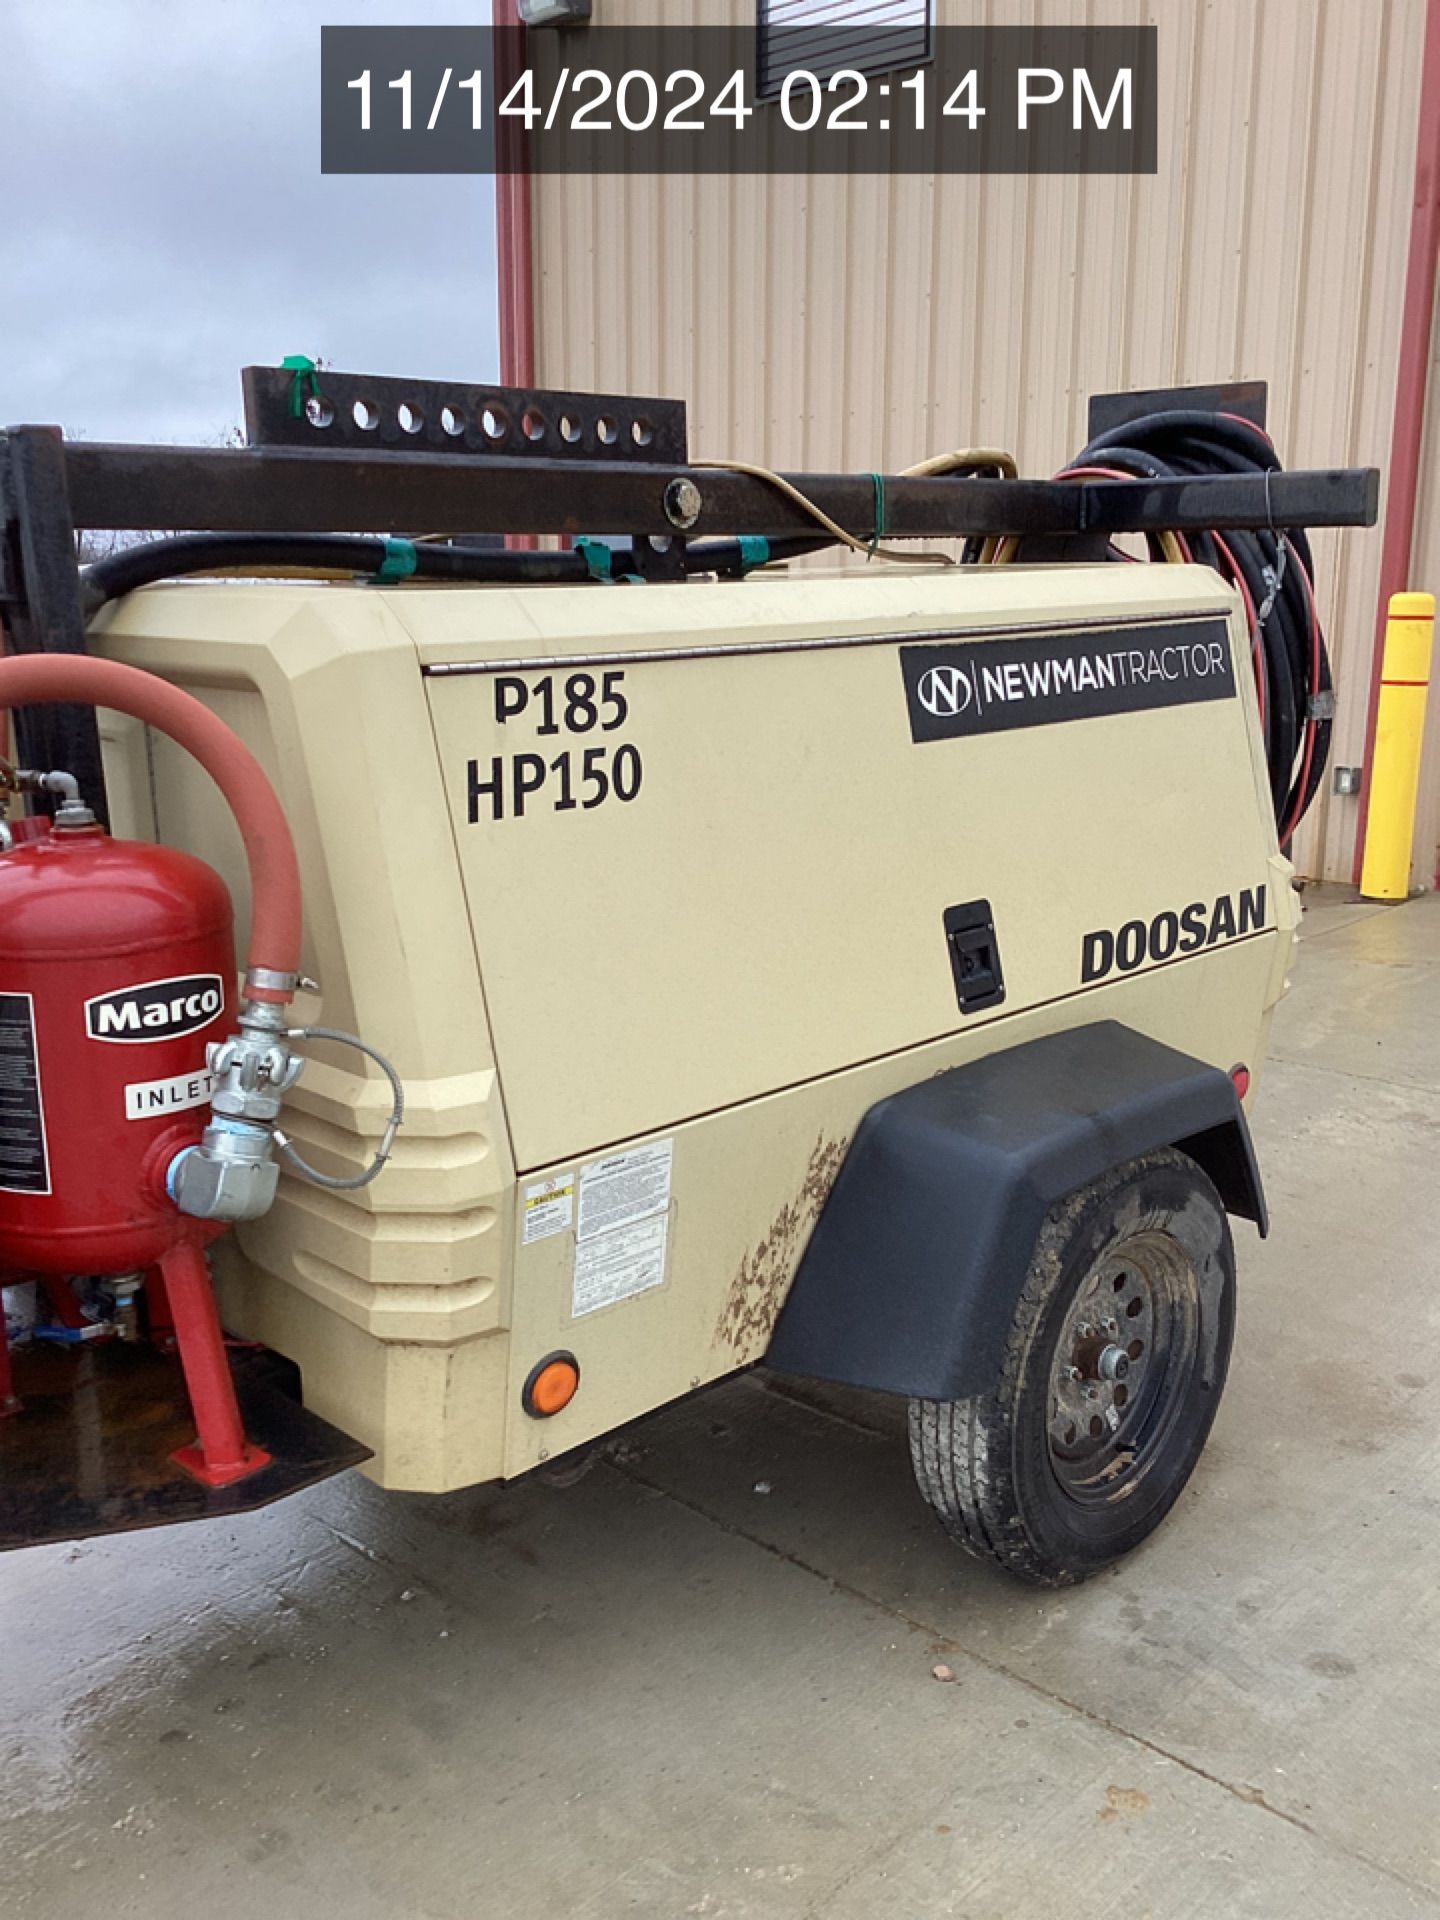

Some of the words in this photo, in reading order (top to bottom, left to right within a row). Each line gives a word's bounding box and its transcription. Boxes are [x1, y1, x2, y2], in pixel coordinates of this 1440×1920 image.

[494, 671, 628, 735] P185
[983, 643, 1226, 704] NEWMANTRACTOR
[467, 743, 643, 824] HP150
[1081, 884, 1268, 983] DOOSAN
[97, 989, 219, 1033] Marco
[137, 1075, 213, 1109] INLET
